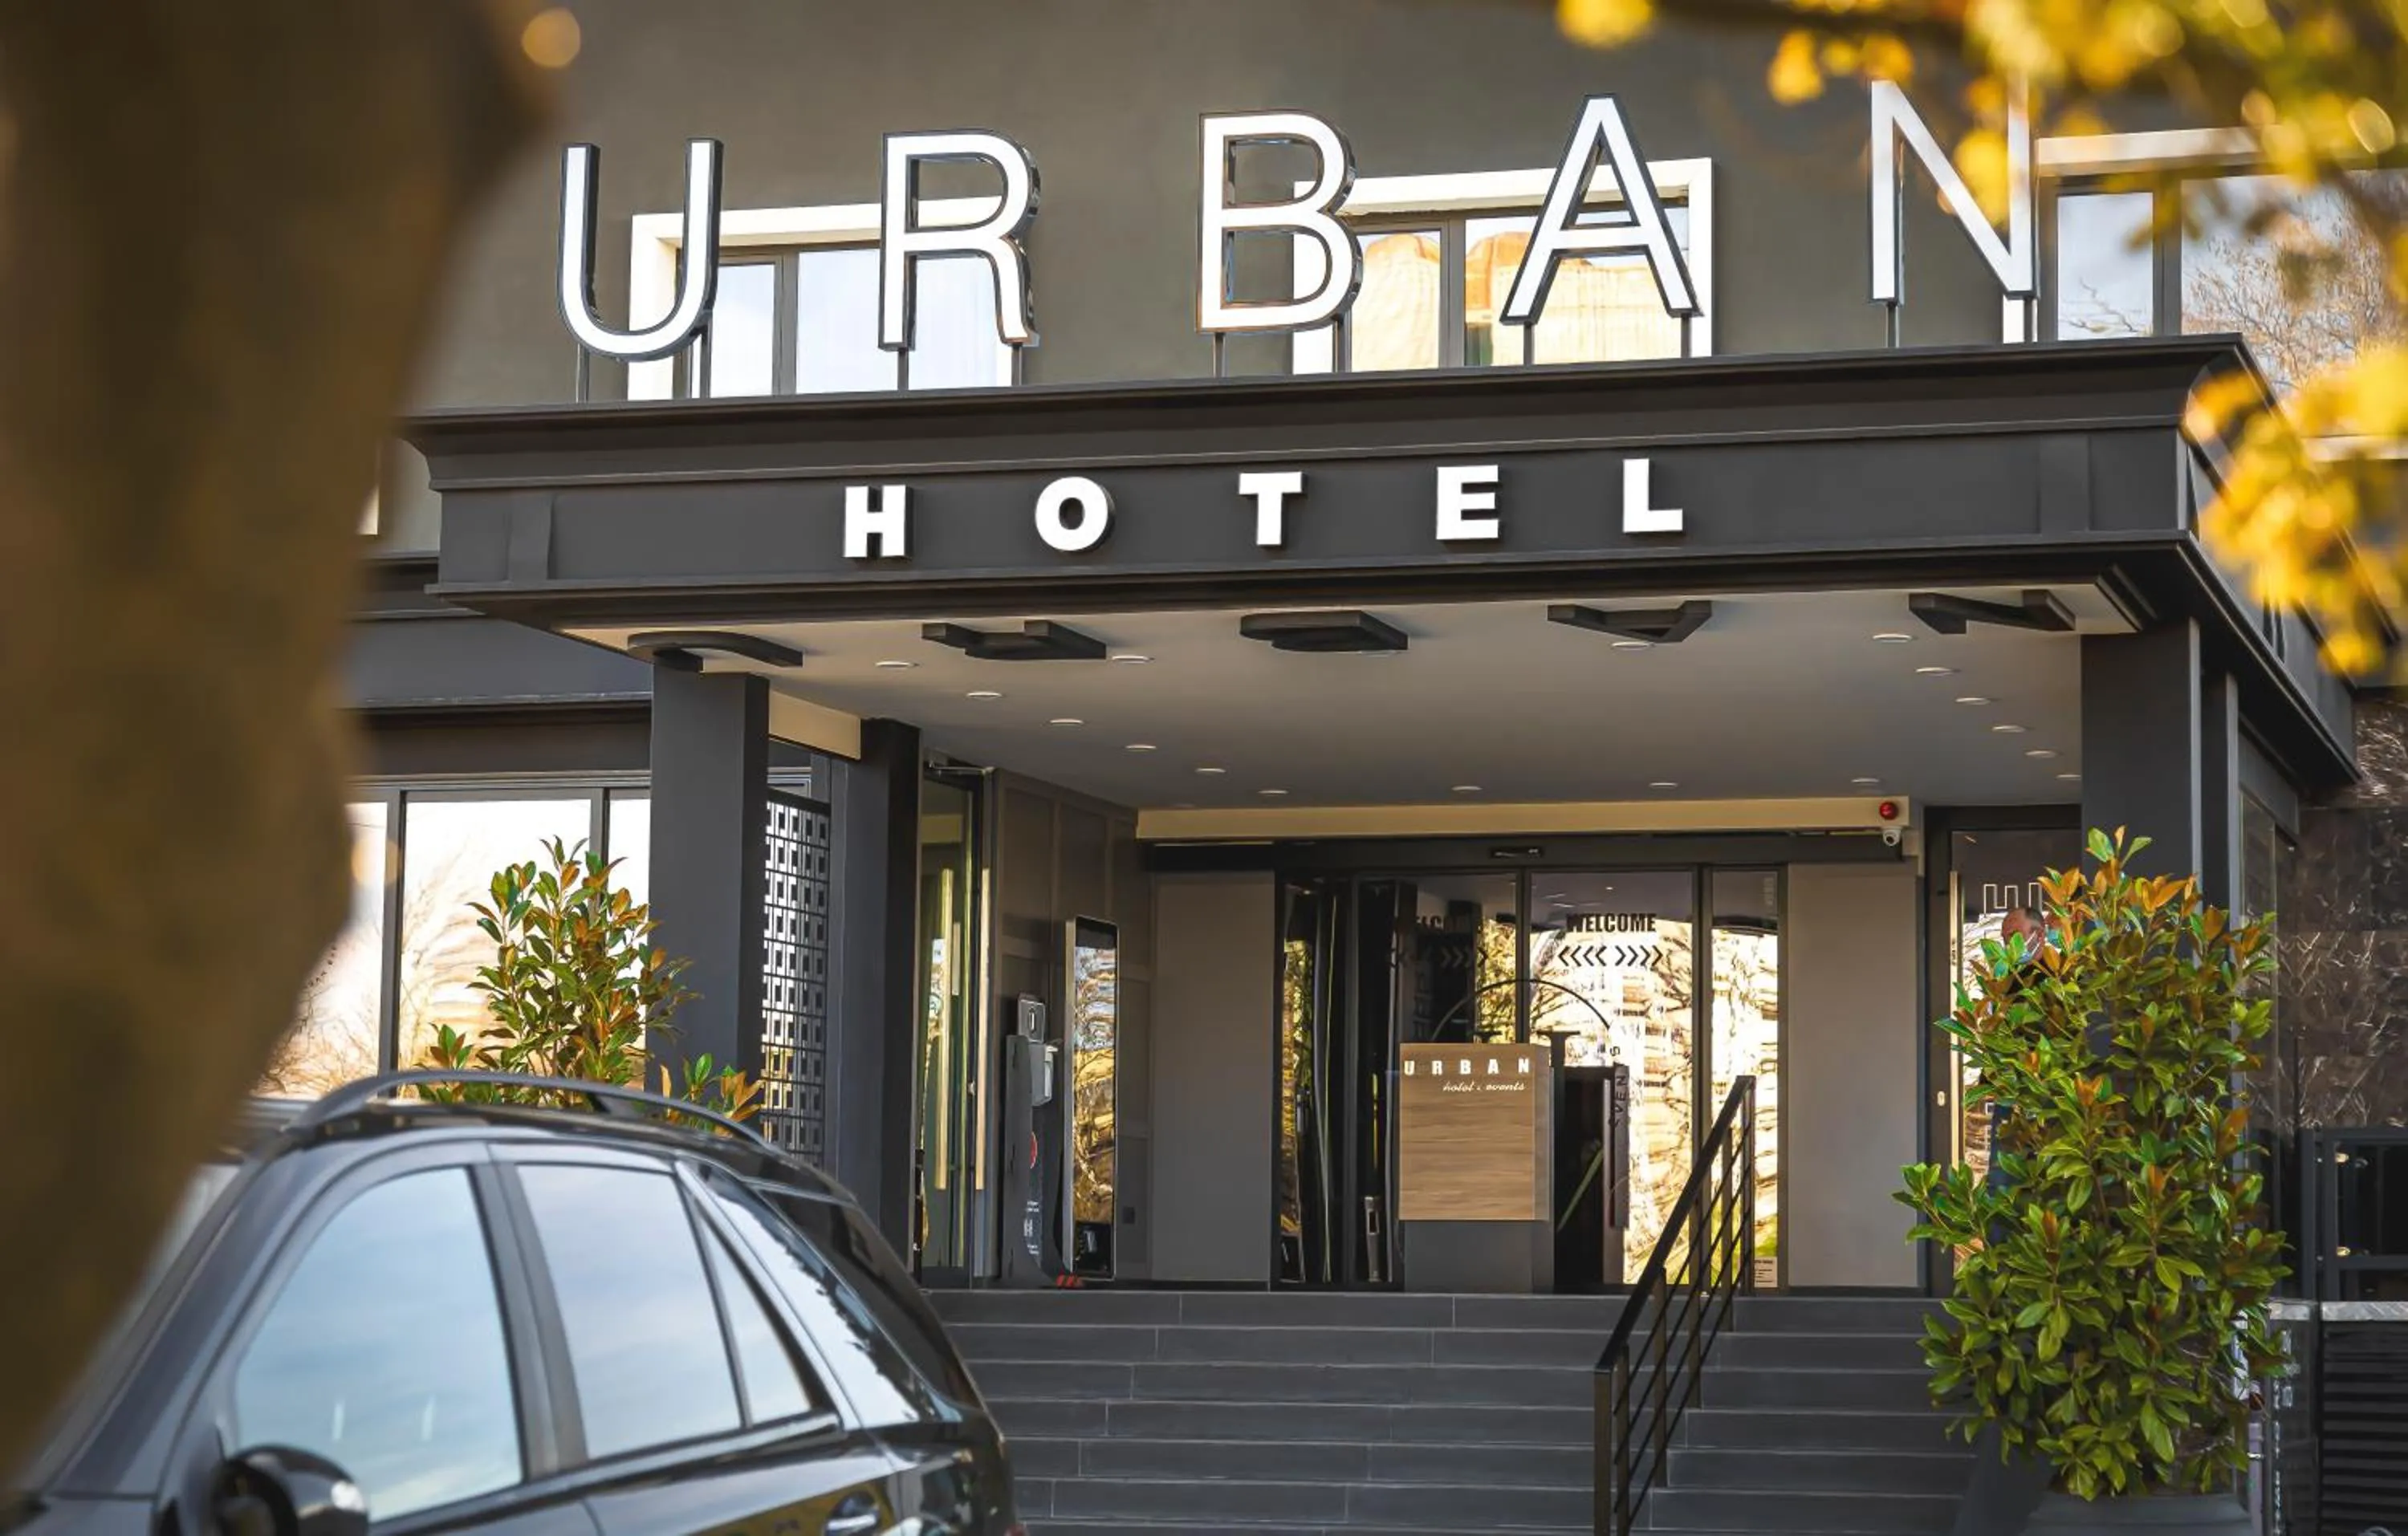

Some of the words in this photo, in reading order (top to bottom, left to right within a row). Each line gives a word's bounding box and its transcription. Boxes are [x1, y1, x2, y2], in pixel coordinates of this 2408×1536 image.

[557, 77, 2036, 361] URBAN
[843, 458, 1684, 560] HOTEL
[1566, 912, 1658, 933] WELCOME
[1404, 1057, 1530, 1076] URBAN
[1442, 1079, 1474, 1092] hotel
[1486, 1080, 1525, 1091] events
